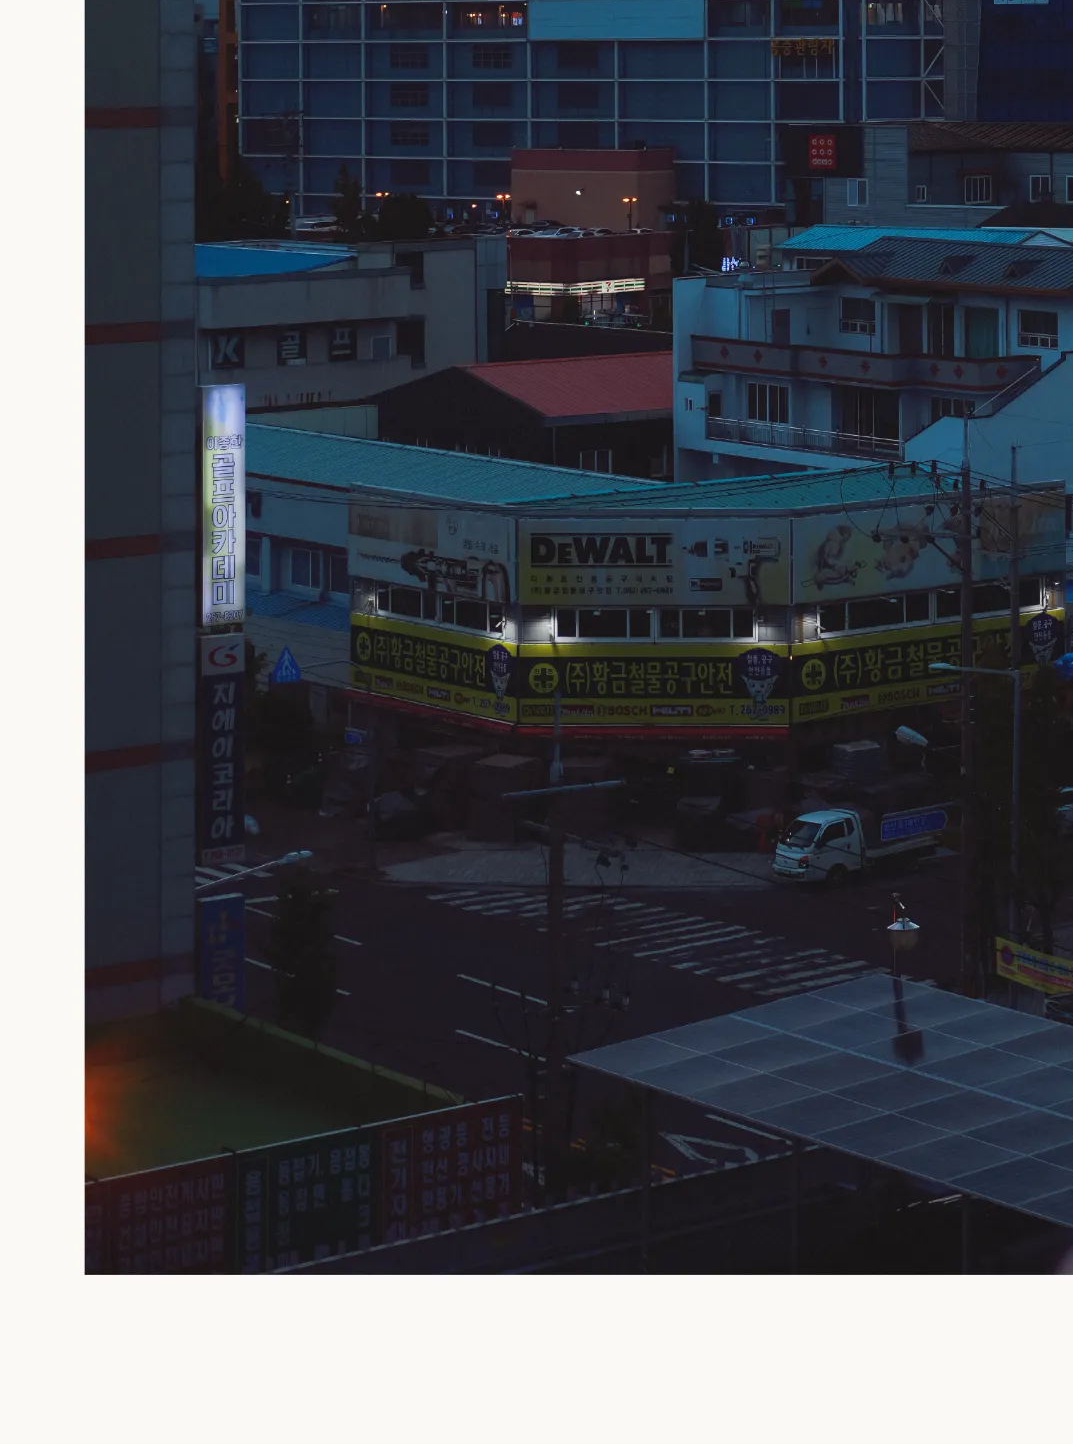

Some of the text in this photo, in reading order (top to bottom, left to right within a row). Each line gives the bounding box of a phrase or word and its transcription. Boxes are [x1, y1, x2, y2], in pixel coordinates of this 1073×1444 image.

[211, 452, 236, 606] 골프아카데미
[373, 632, 487, 688] (주)황금철물공구안전
[565, 660, 734, 695] (주)황금철물공구안전
[210, 681, 236, 840] 지에이코리아
